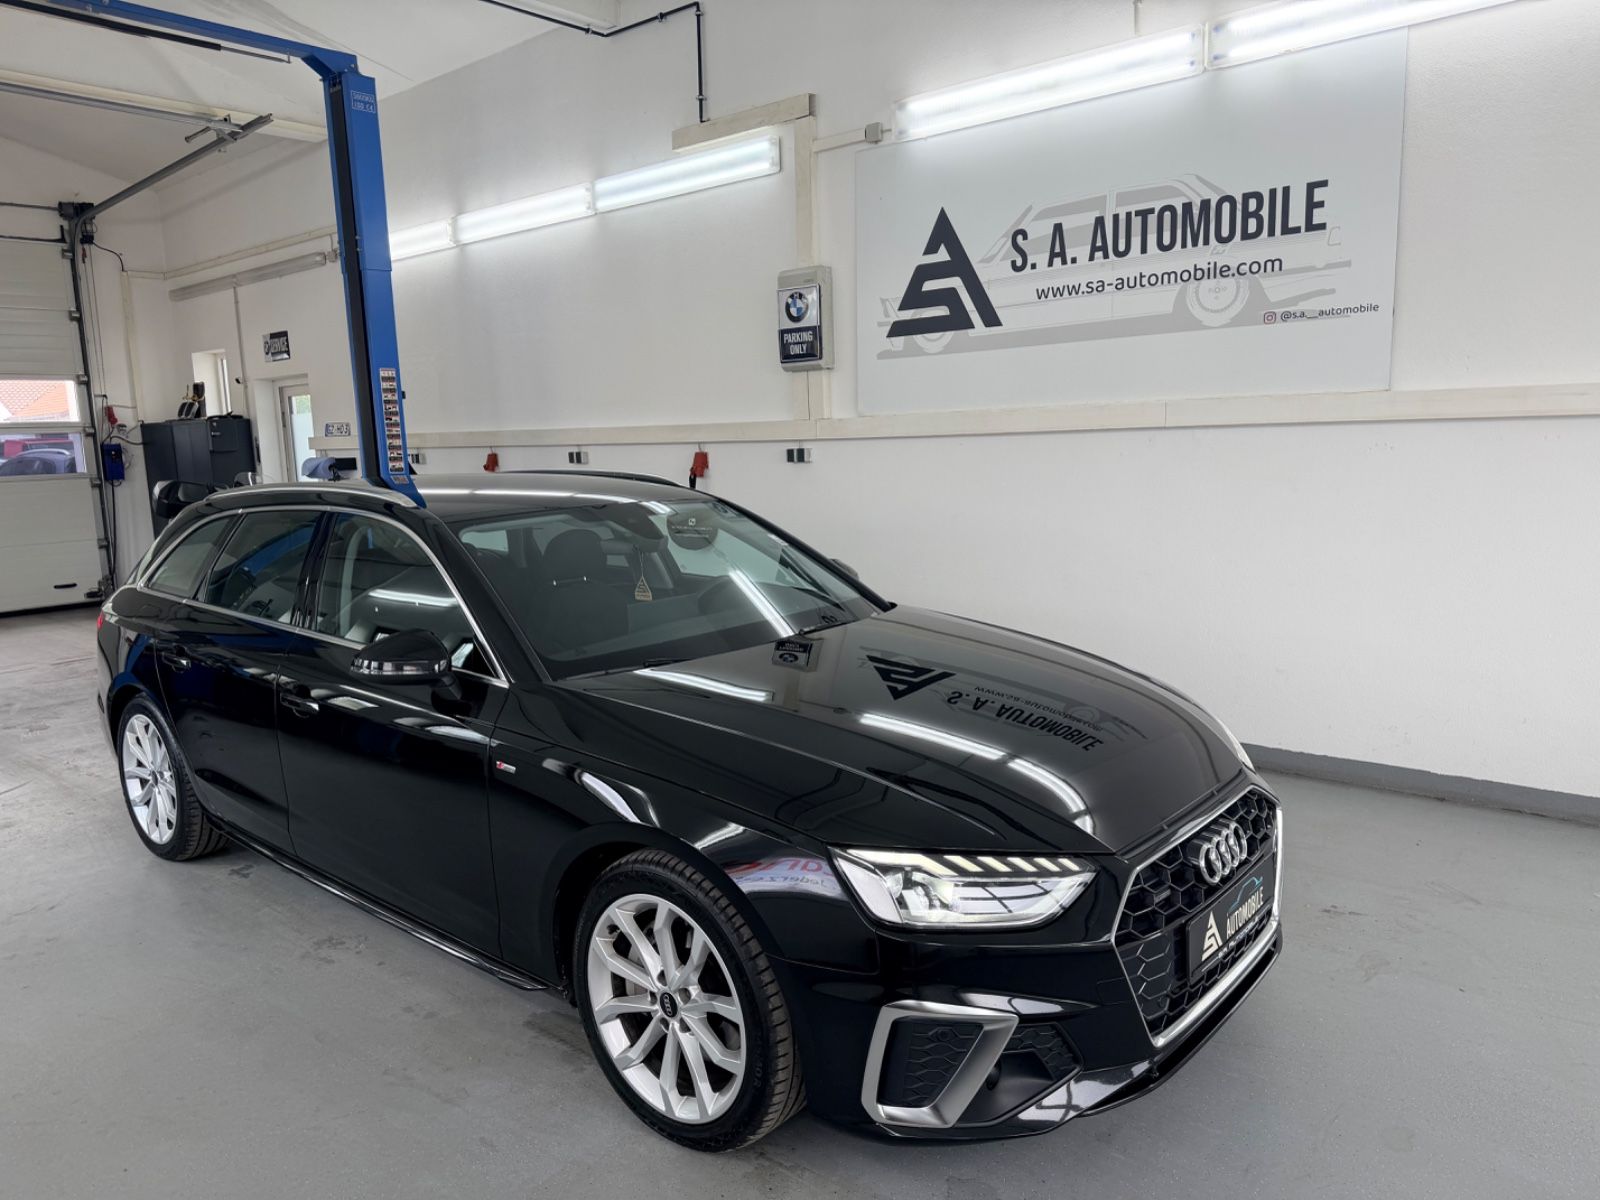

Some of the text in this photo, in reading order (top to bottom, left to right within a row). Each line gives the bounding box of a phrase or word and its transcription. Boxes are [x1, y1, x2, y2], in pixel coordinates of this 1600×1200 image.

[1010, 179, 1329, 273] S. A. AUTOMOBILE
[1036, 257, 1283, 300] www.sa-automobile.com
[784, 331, 813, 343] PARKING
[789, 343, 808, 355] ONLY
[1226, 887, 1264, 939] AUTOMOBILE
